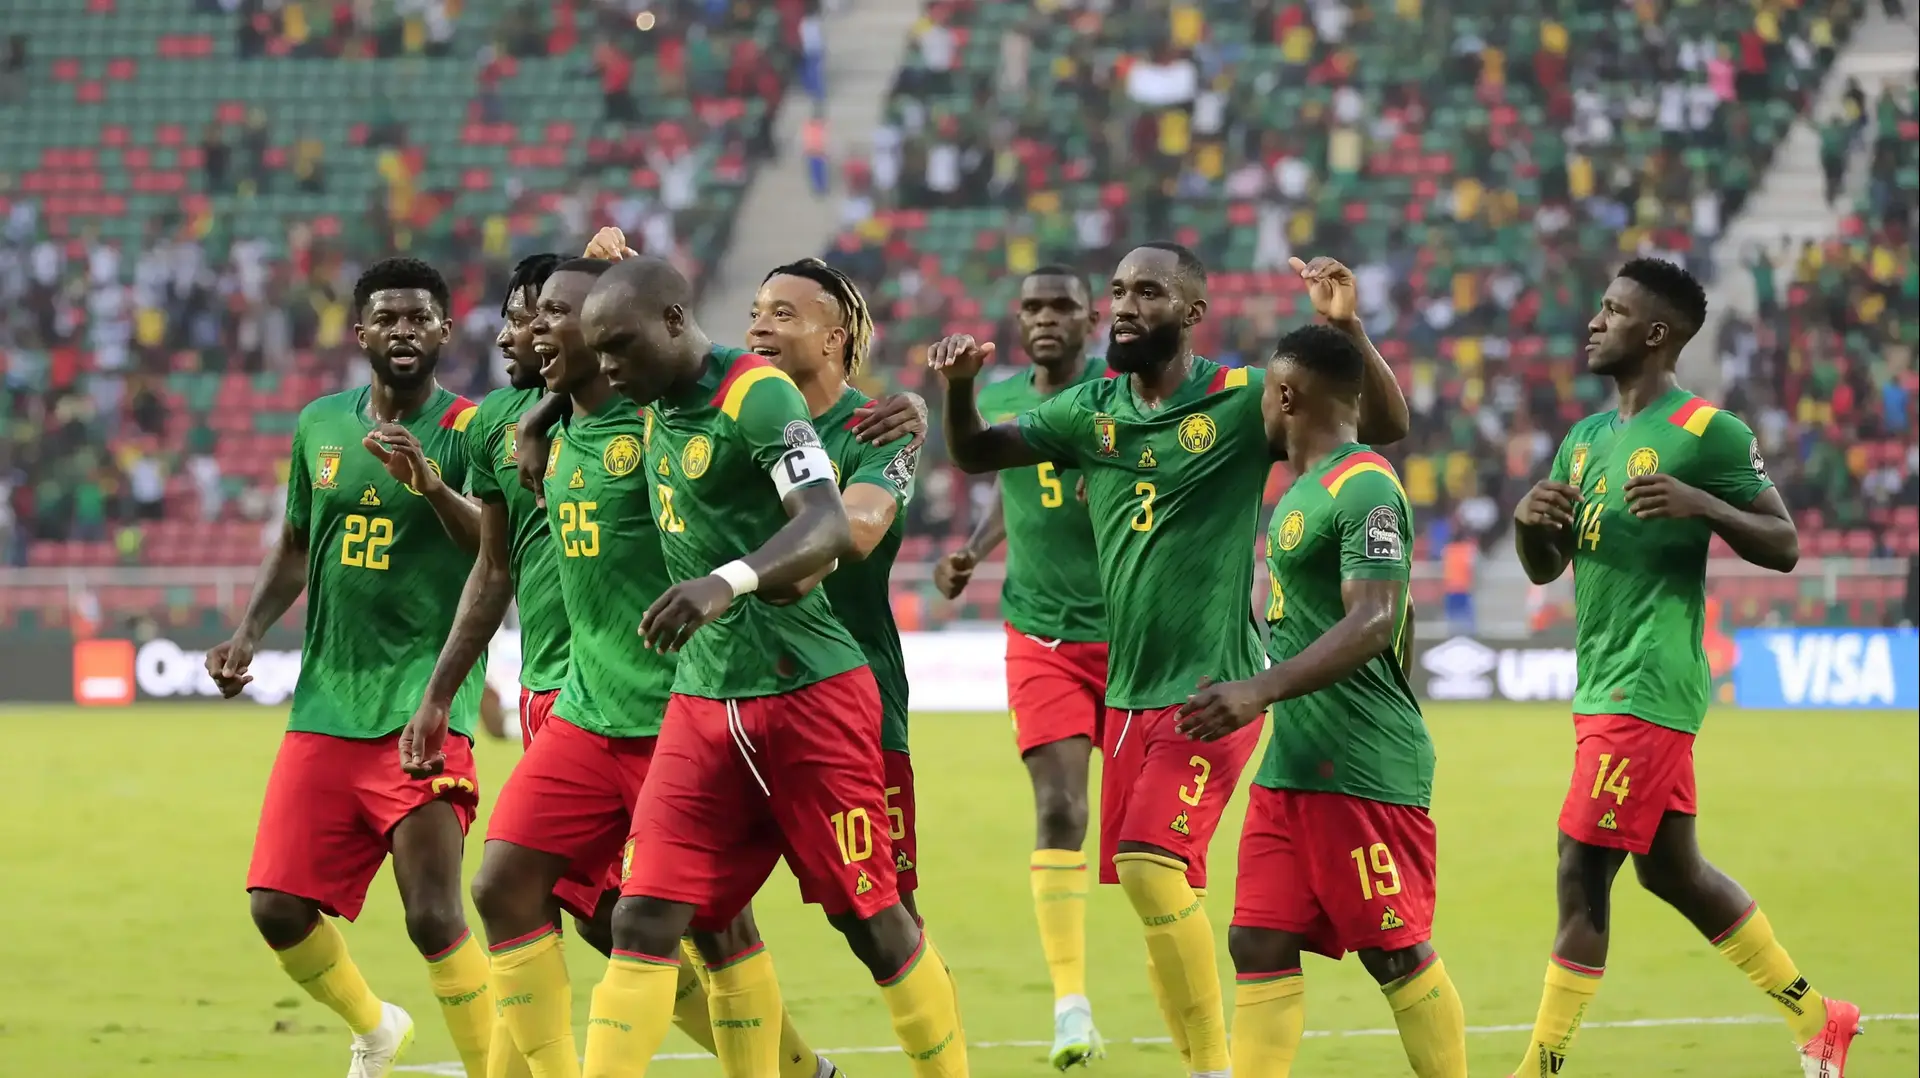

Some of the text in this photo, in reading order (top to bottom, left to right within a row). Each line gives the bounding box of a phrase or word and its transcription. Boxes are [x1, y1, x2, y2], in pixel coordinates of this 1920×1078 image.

[784, 450, 811, 483] C
[1036, 461, 1063, 508] 5
[559, 501, 600, 558] 25
[1131, 482, 1156, 532] 3
[1577, 503, 1604, 551] 14
[341, 514, 394, 570] 22
[138, 639, 301, 703] Orge
[1497, 647, 1577, 702] um
[1768, 634, 1897, 703] VISA
[1179, 755, 1211, 807] 3
[1591, 753, 1631, 806] 14
[831, 807, 873, 865] 10
[1351, 843, 1401, 900] 19
[712, 1017, 763, 1028] SPORTIF
